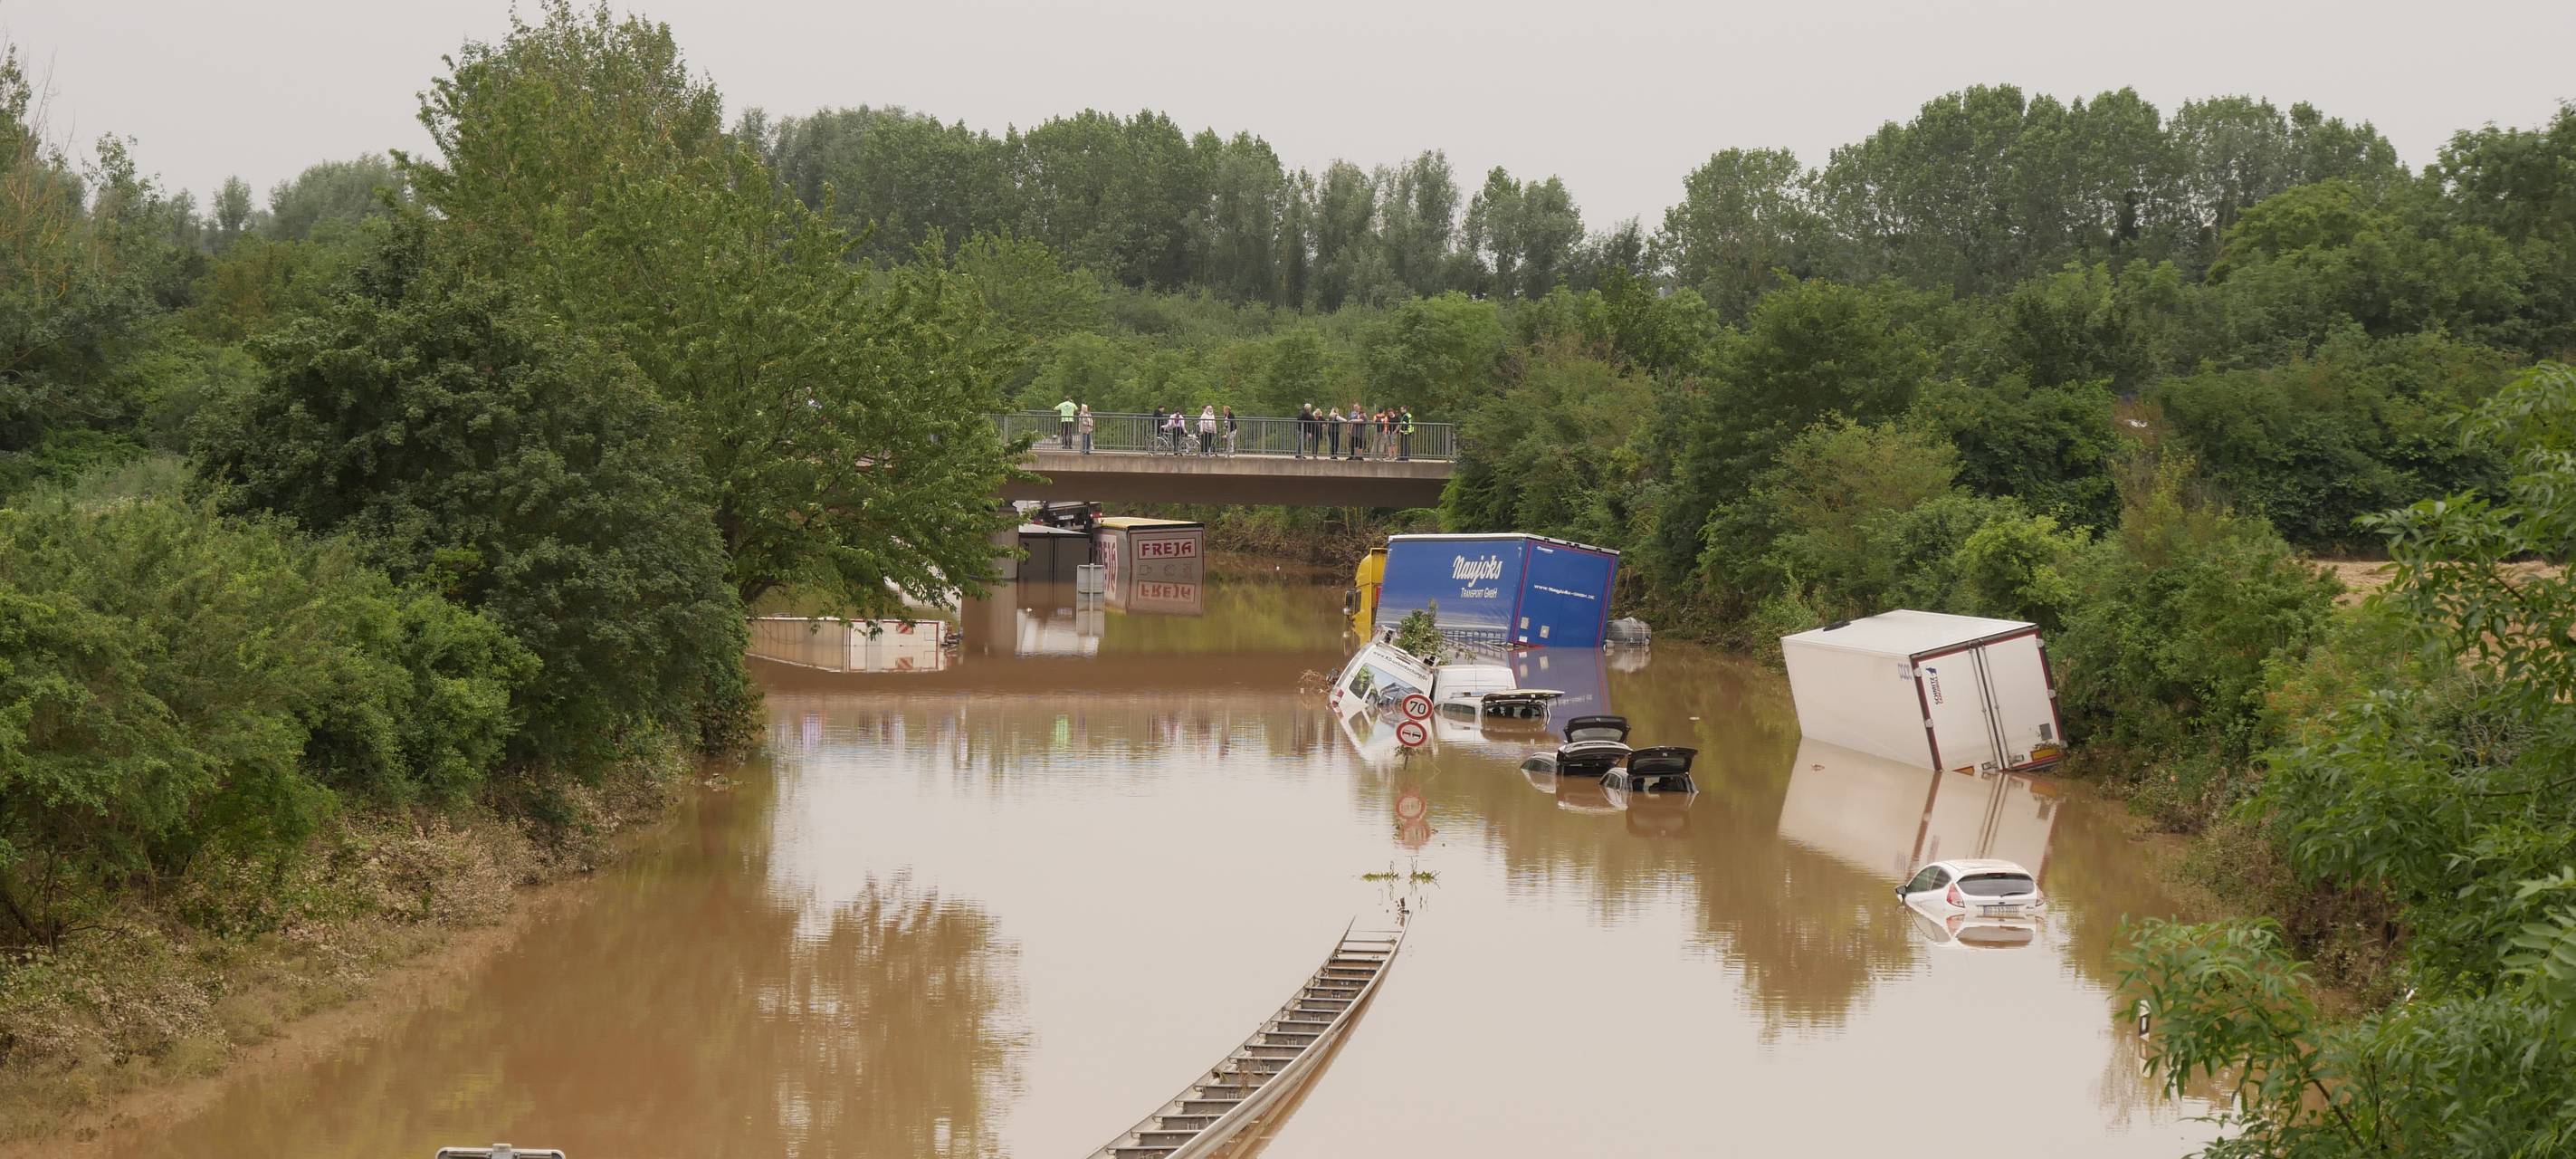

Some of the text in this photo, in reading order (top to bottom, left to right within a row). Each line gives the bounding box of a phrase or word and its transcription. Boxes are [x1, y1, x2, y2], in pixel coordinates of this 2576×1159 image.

[1141, 541, 1192, 556] FREJA
[1452, 554, 1503, 588] Naujoks
[1409, 701, 1426, 714] 70
